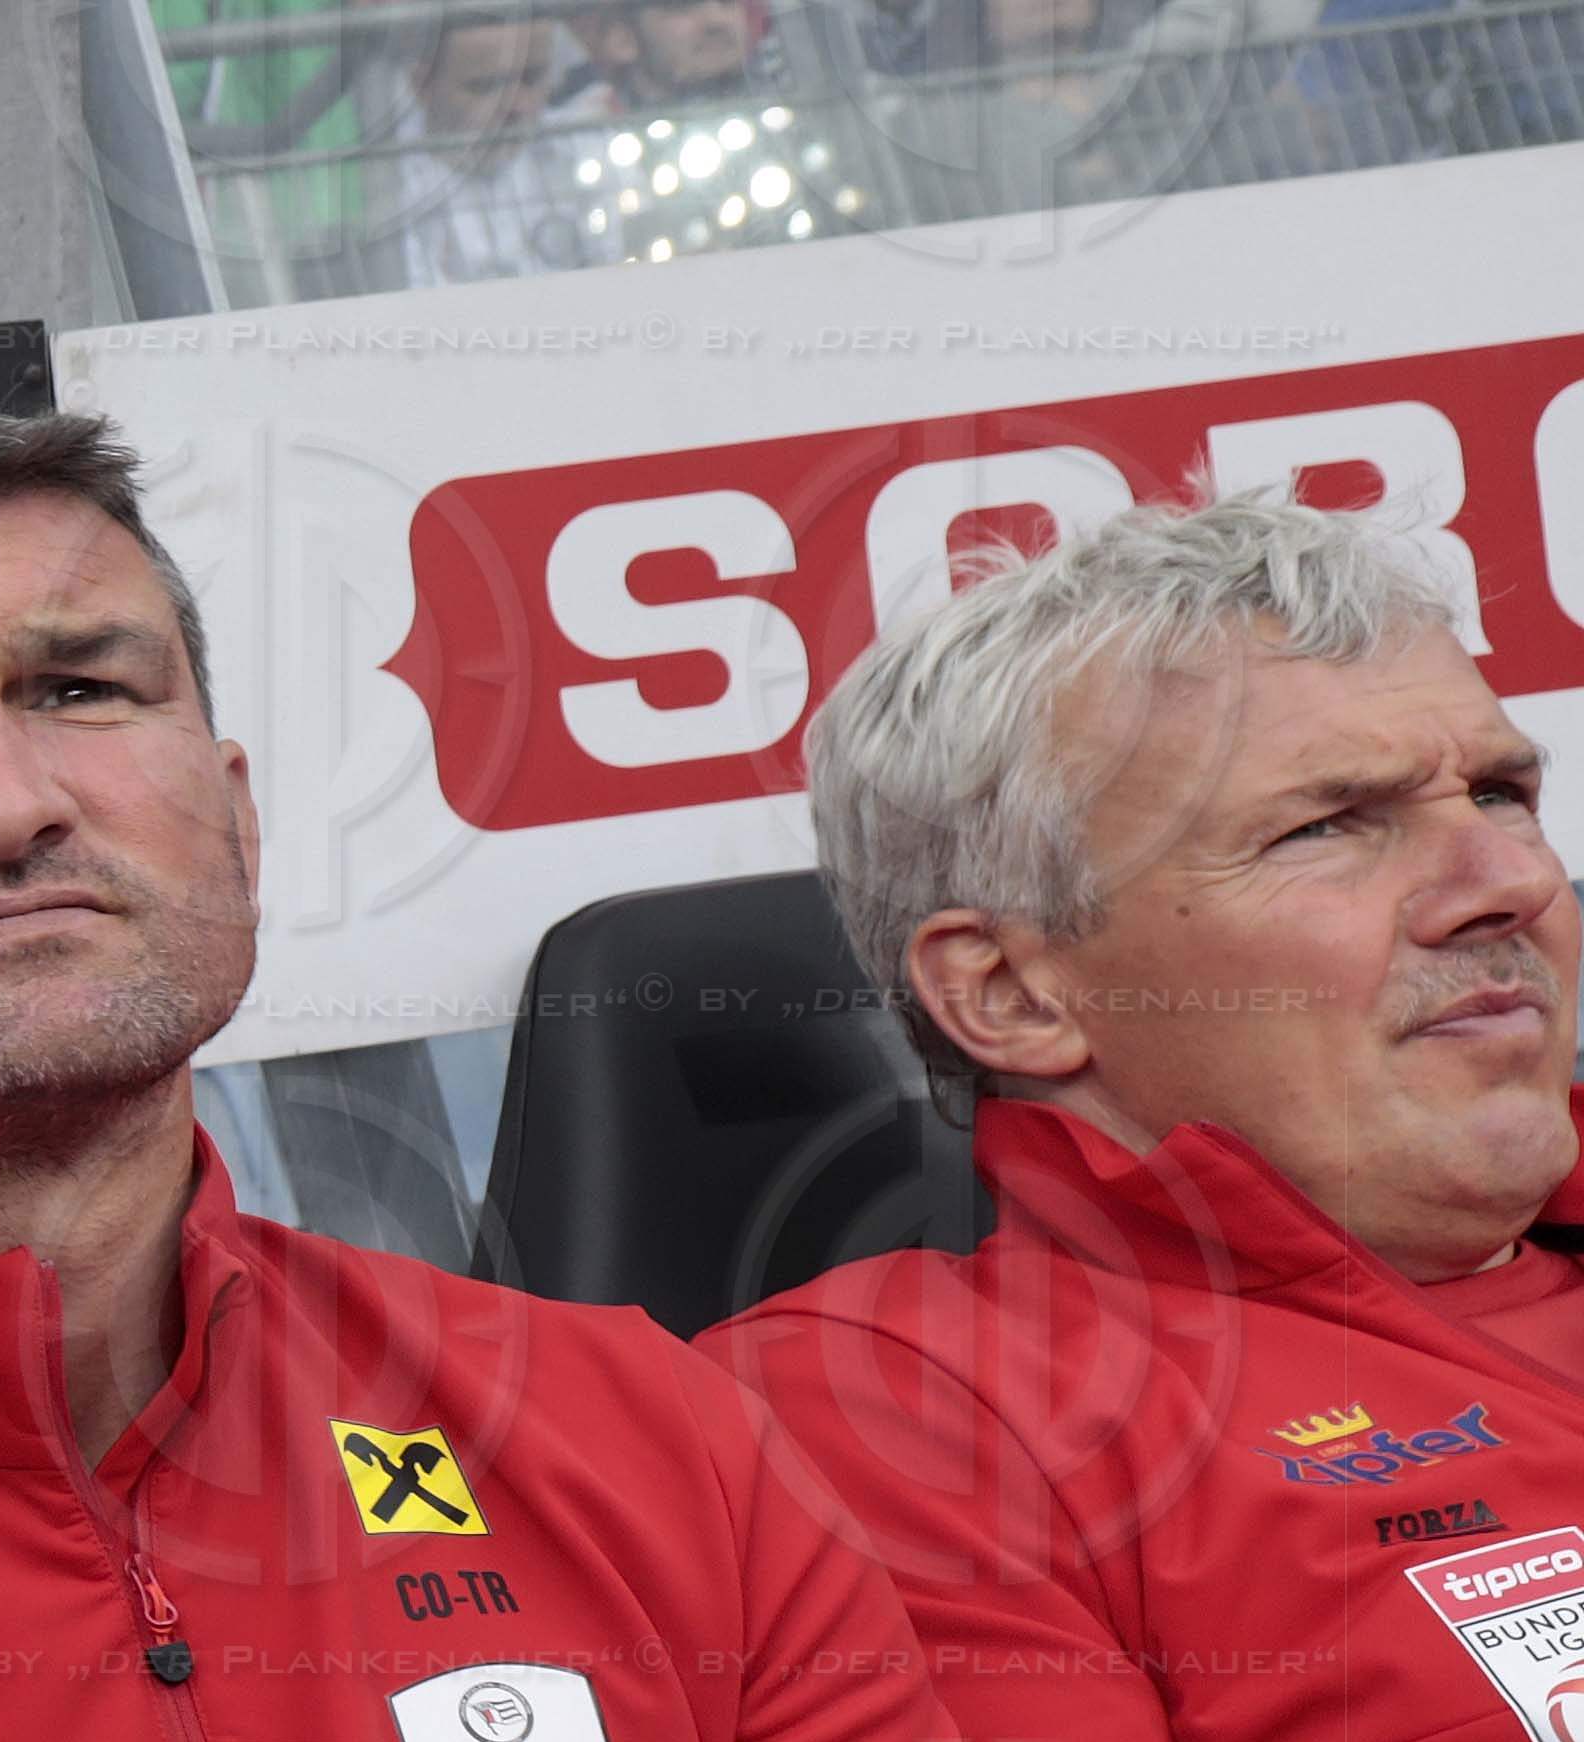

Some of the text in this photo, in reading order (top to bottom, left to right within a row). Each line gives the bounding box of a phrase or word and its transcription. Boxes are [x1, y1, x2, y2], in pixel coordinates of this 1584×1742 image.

[1375, 1499, 1500, 1543] FORZA
[395, 1570, 520, 1622] CO-TR
[1443, 1549, 1583, 1601] tipico
